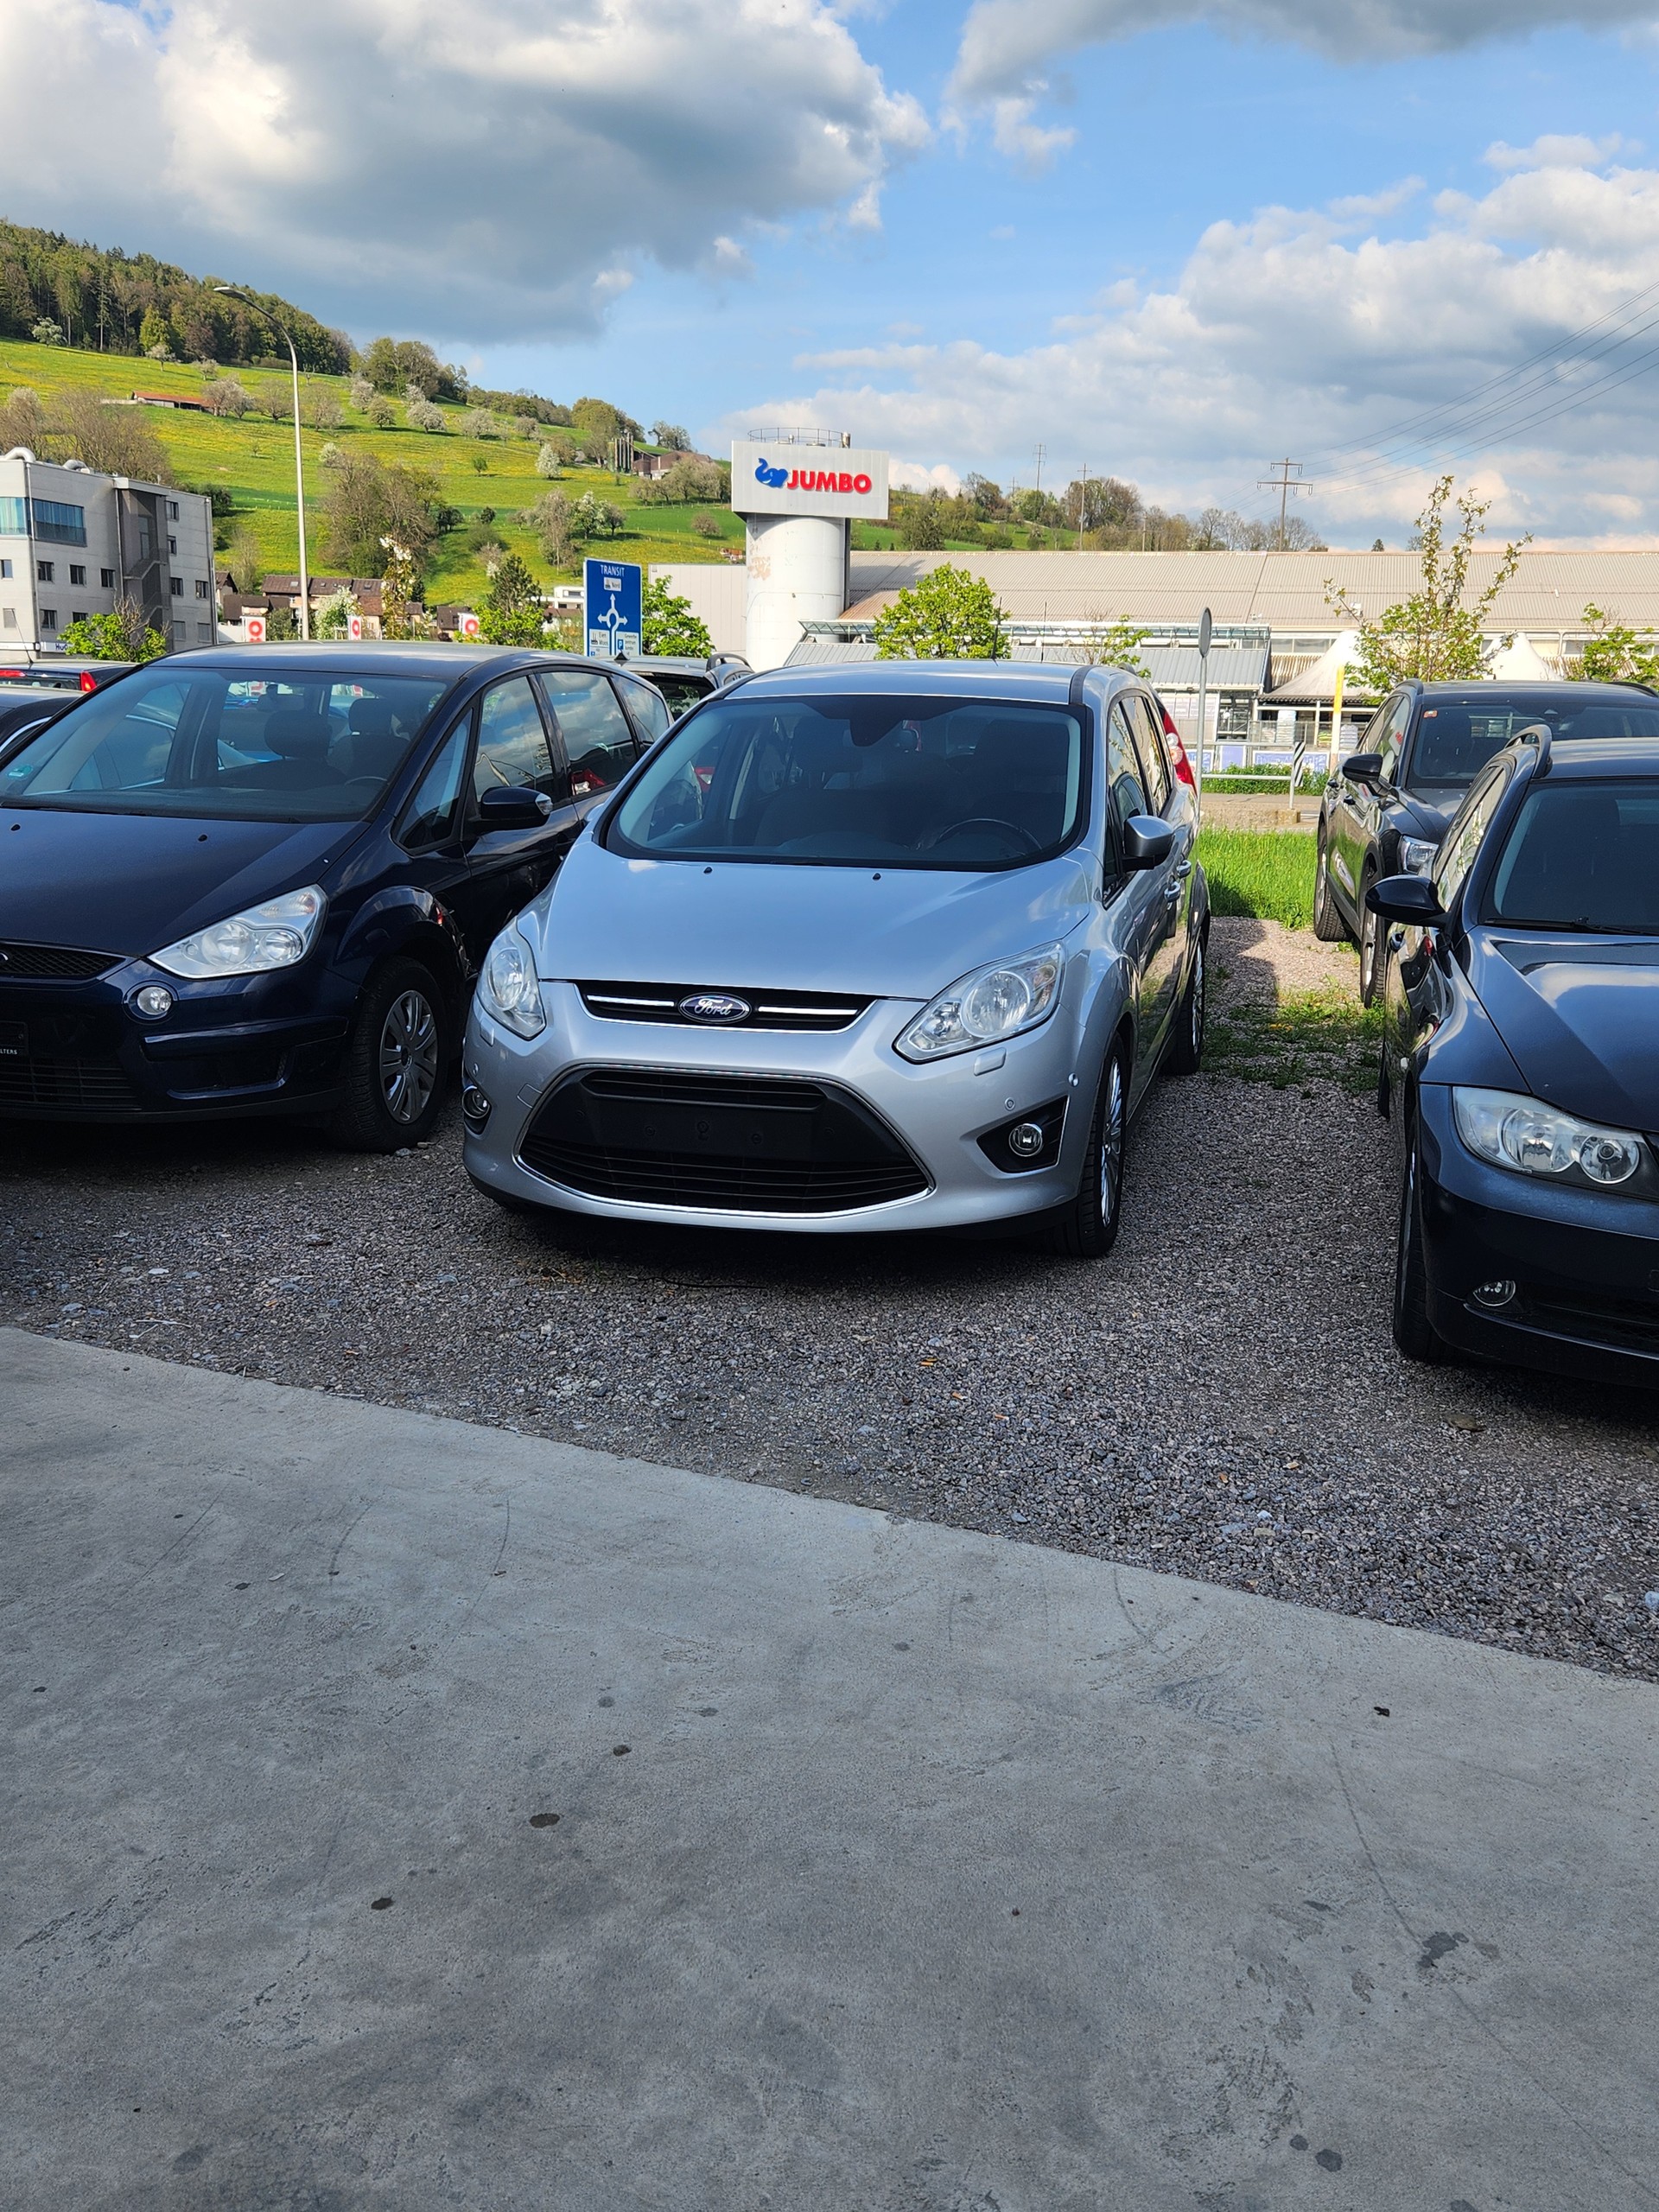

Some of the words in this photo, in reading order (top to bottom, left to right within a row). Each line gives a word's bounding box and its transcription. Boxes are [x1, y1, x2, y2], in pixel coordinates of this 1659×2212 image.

[787, 469, 872, 494] JUMBO
[600, 564, 625, 576] TRANSIT
[694, 998, 733, 1015] Ford
